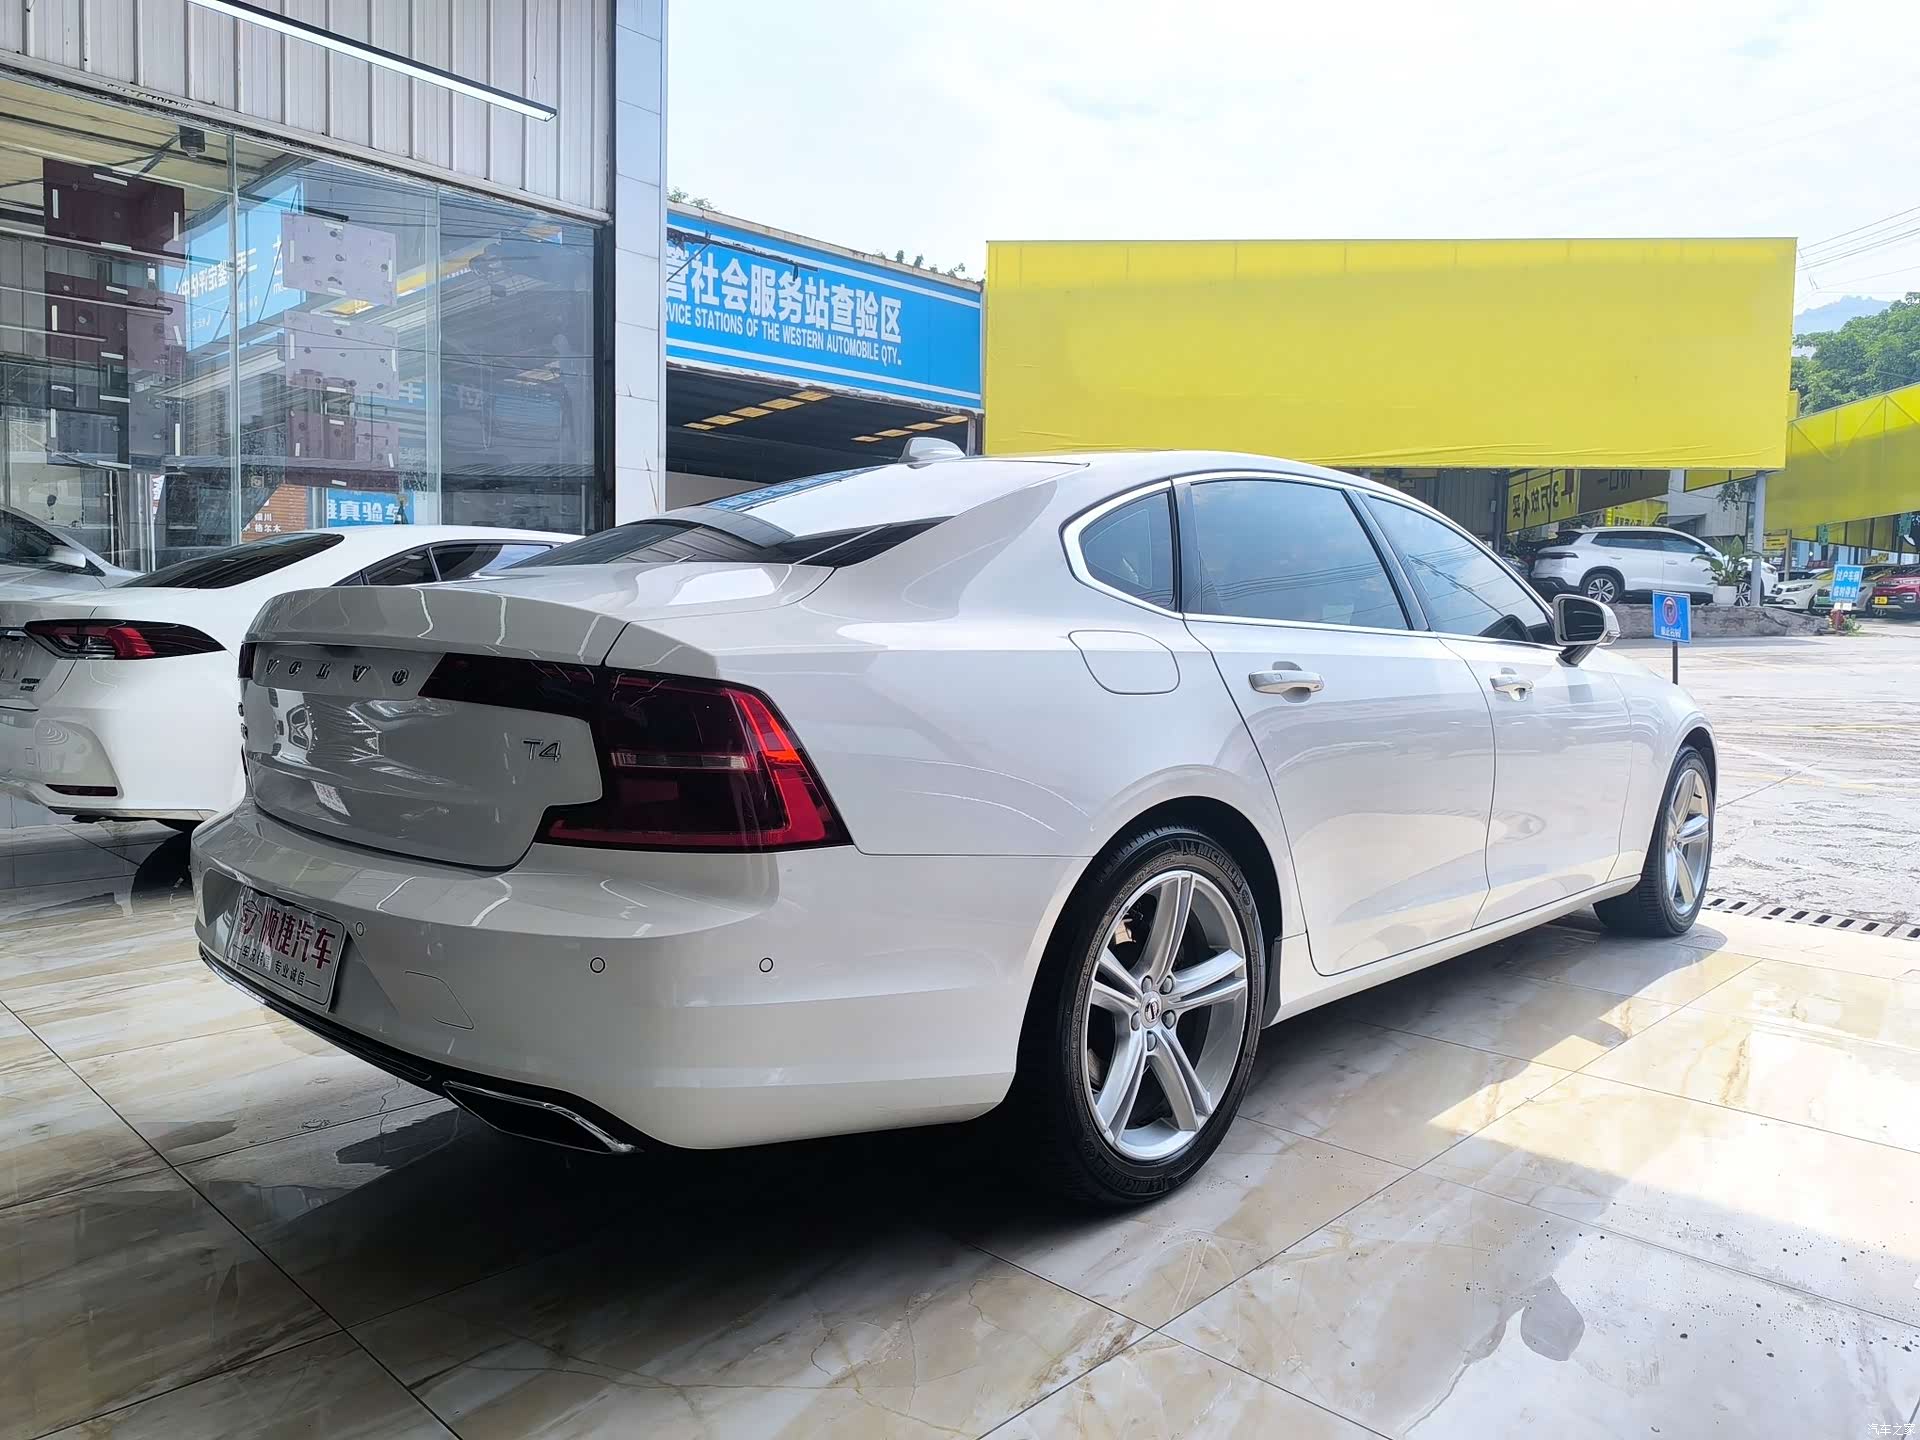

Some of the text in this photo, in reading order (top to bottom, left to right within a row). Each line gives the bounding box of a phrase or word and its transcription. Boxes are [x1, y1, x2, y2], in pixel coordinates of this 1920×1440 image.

[666, 301, 692, 326] VICE
[695, 307, 744, 336] STATIONS
[746, 318, 759, 337] OF
[762, 320, 780, 342] THE
[782, 324, 824, 351] WESTERN
[826, 334, 879, 361] AUTOMOBILE
[266, 658, 410, 686] VOLVO
[523, 739, 561, 761] T4
[1197, 843, 1243, 888] MICHELIN
[274, 960, 306, 986] 专业诚信
